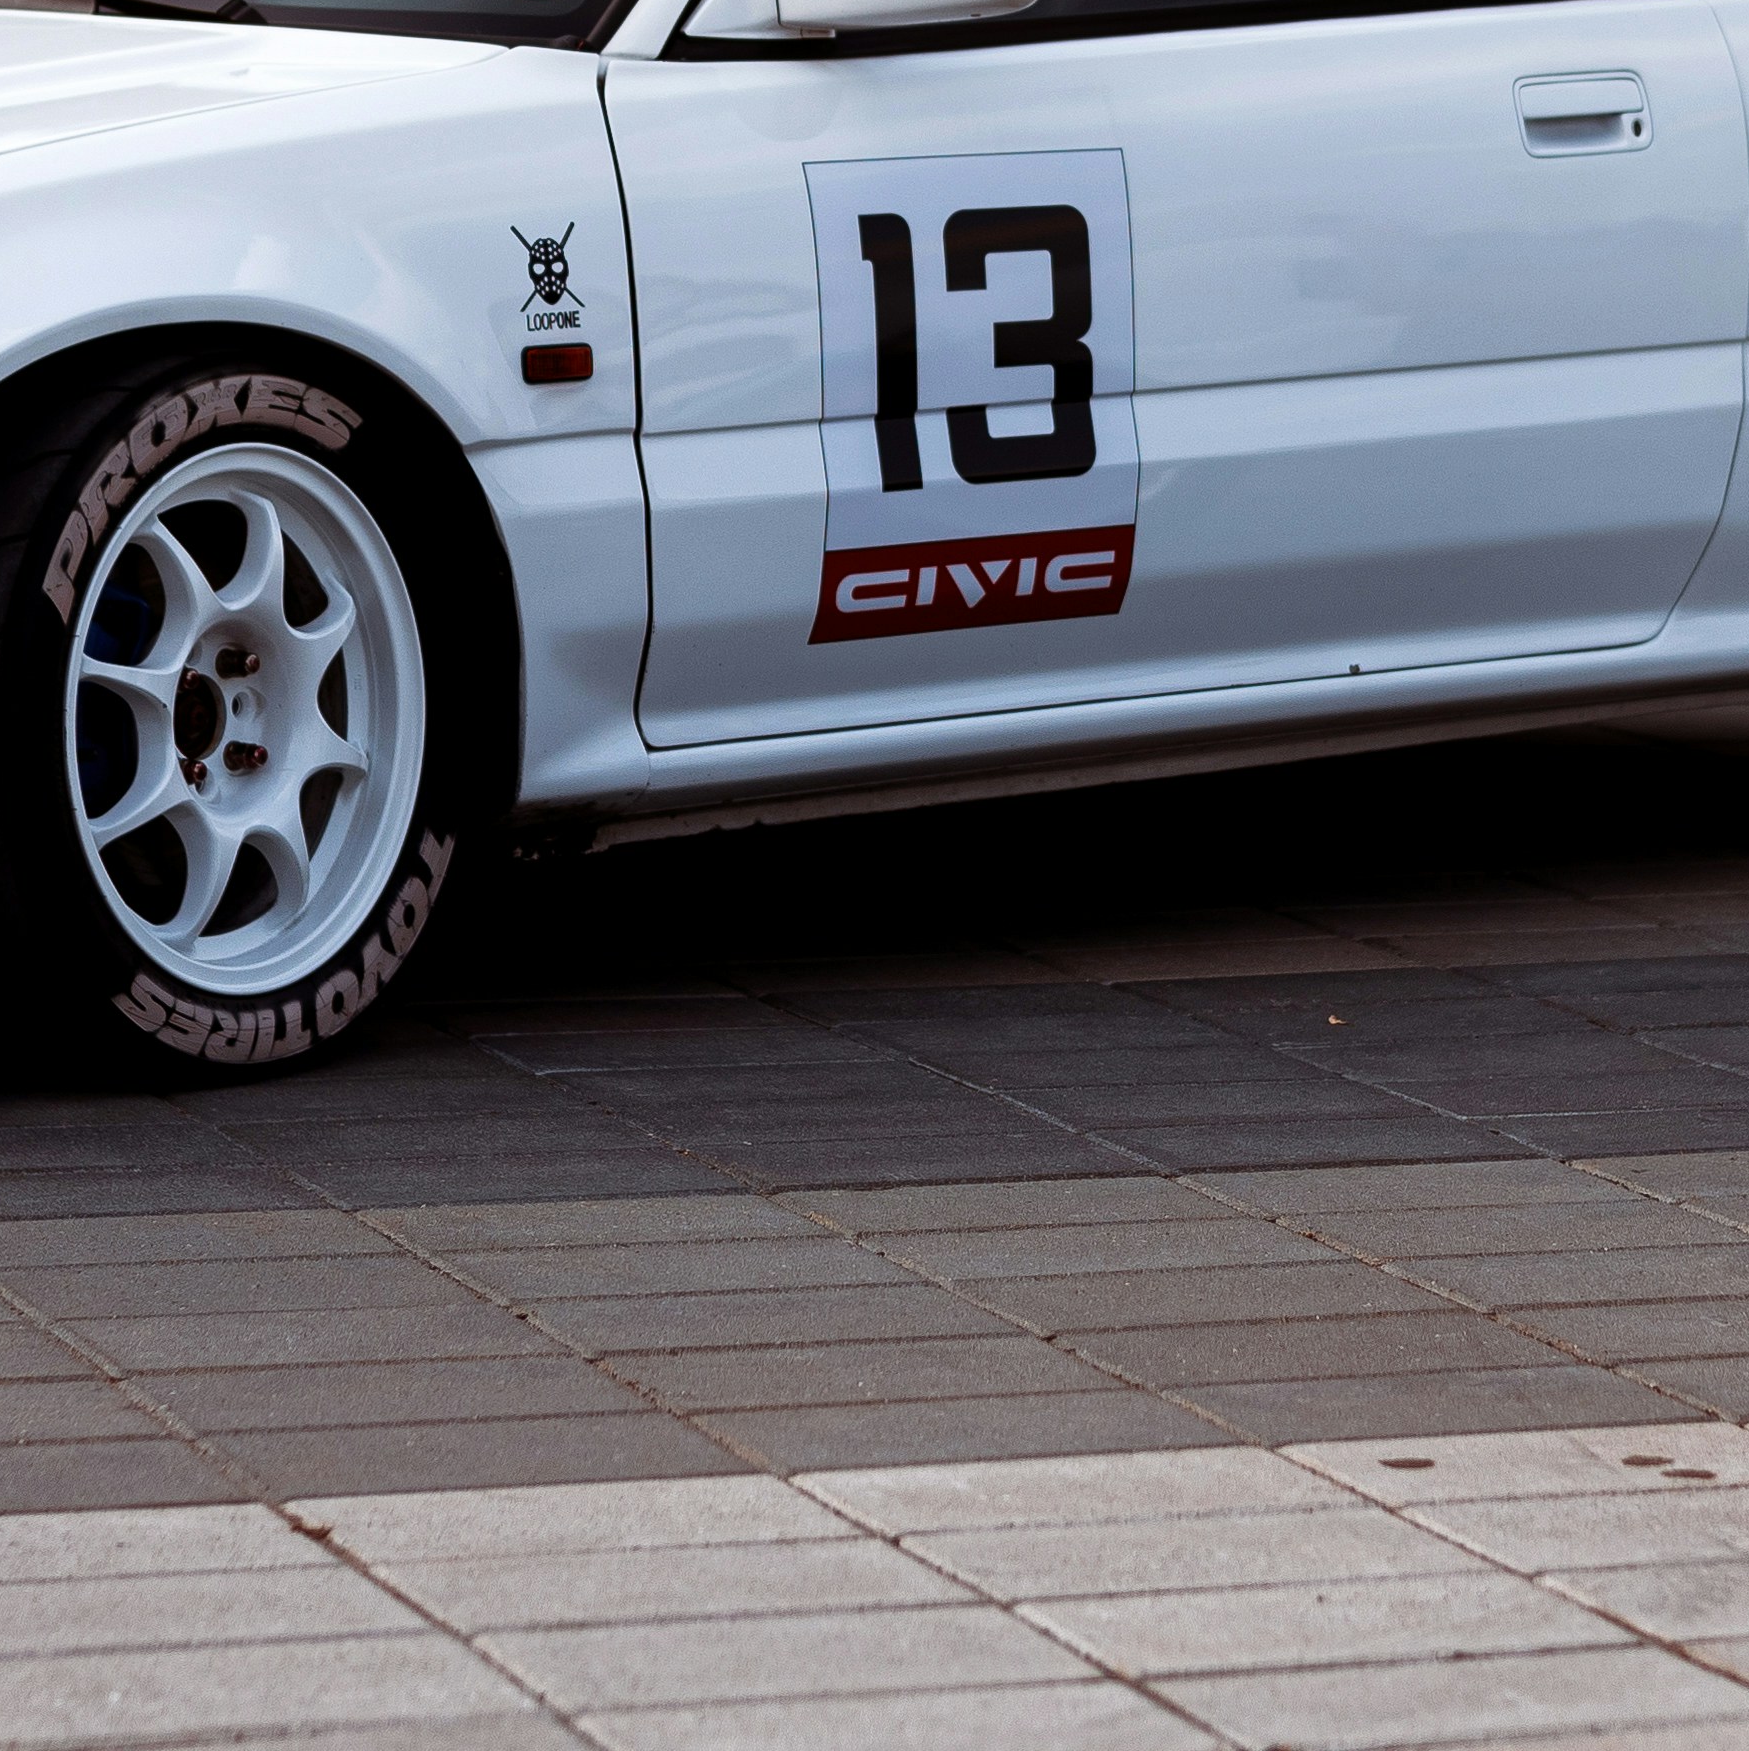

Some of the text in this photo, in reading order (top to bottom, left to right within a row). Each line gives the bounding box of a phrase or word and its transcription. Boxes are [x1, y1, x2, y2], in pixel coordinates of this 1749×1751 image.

[526, 310, 582, 332] LOOPONE
[857, 203, 1097, 494] 13
[41, 374, 364, 626] PROXES
[835, 550, 1116, 613] CIVIC
[111, 824, 455, 1064] TOYO TIRES
